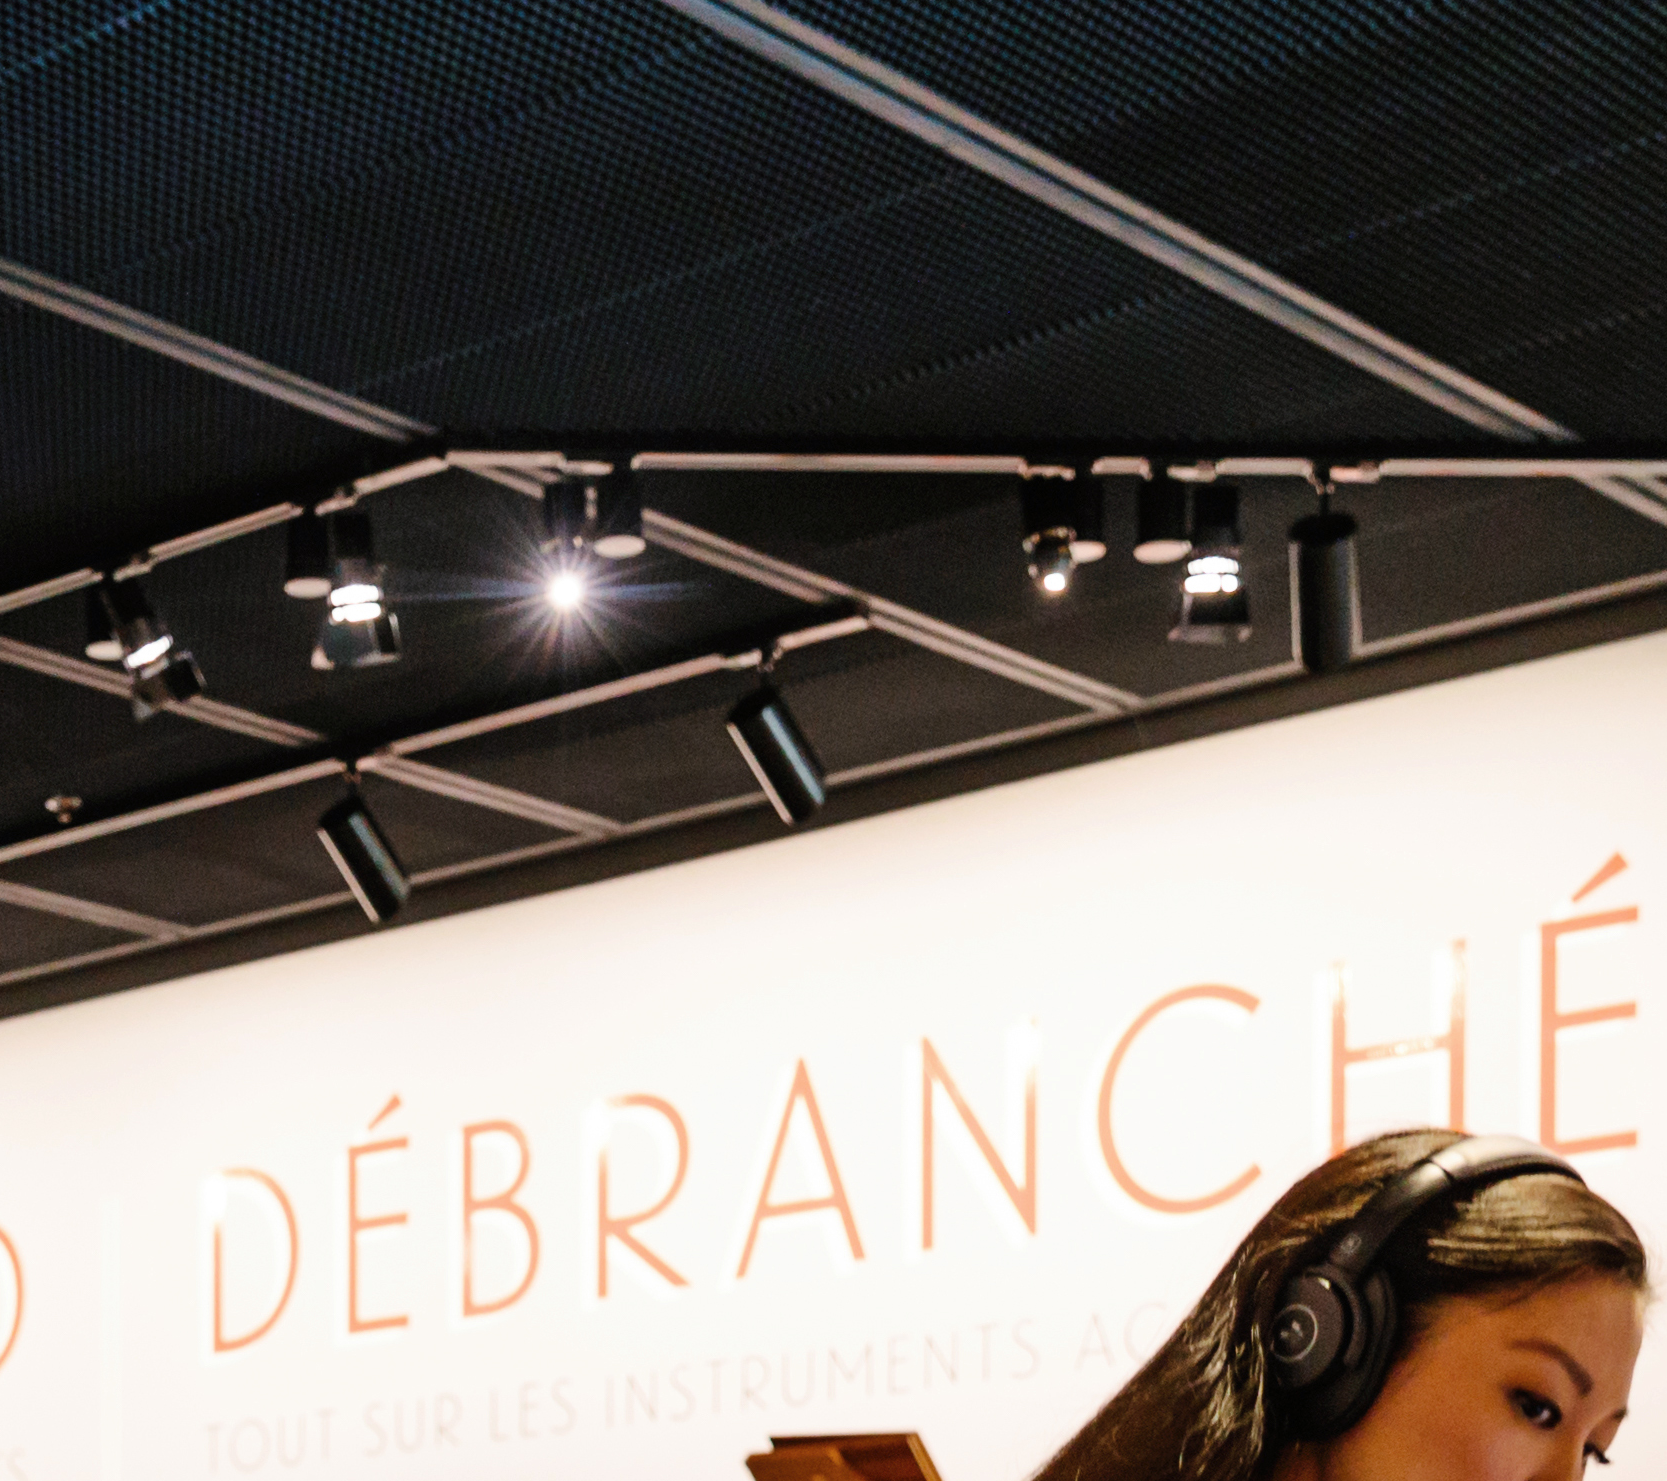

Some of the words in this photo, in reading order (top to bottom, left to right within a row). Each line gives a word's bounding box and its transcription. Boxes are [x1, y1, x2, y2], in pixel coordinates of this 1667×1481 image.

[208, 852, 1642, 1354] DÉBRANCHÉ
[203, 1405, 334, 1474] TOUT
[360, 1392, 465, 1460] SUR
[488, 1376, 577, 1443] LES
[603, 1317, 1042, 1431] INSTRUMENTS
